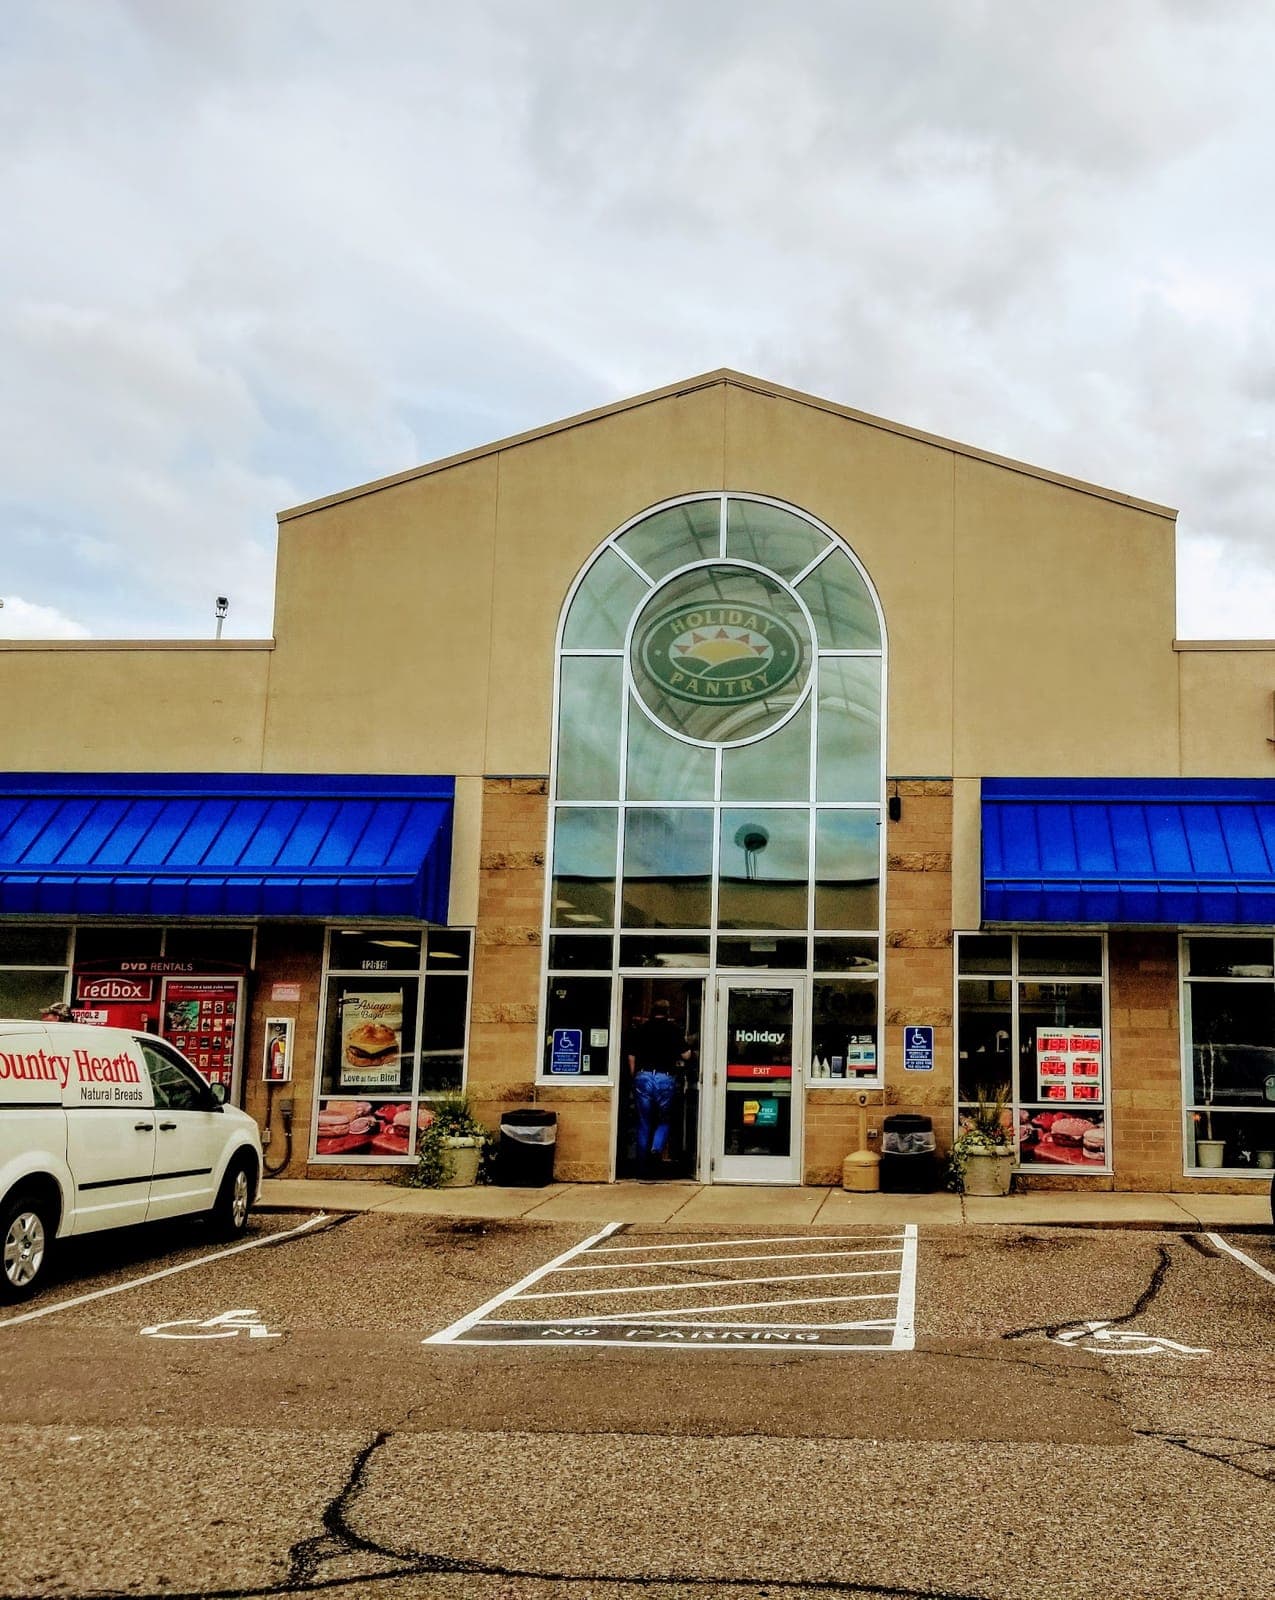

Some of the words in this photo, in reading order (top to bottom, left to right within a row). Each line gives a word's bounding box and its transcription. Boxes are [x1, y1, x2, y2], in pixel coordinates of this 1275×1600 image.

[669, 609, 776, 635] HOLIDAY
[669, 671, 770, 696] PANTRY
[121, 962, 147, 971] DVD
[150, 962, 193, 971] RENTALS
[83, 978, 143, 998] redbox
[354, 999, 392, 1013] Asiago
[735, 1029, 785, 1045] Holiday
[72, 1049, 141, 1083] Hearth
[752, 1067, 771, 1075] EXIT
[343, 1074, 360, 1082] Love
[380, 1073, 398, 1082] Bite!
[80, 1087, 112, 1100] Natural
[114, 1088, 143, 1101] Breads
[541, 1327, 600, 1337] NO
[626, 1329, 821, 1341] PARKING
